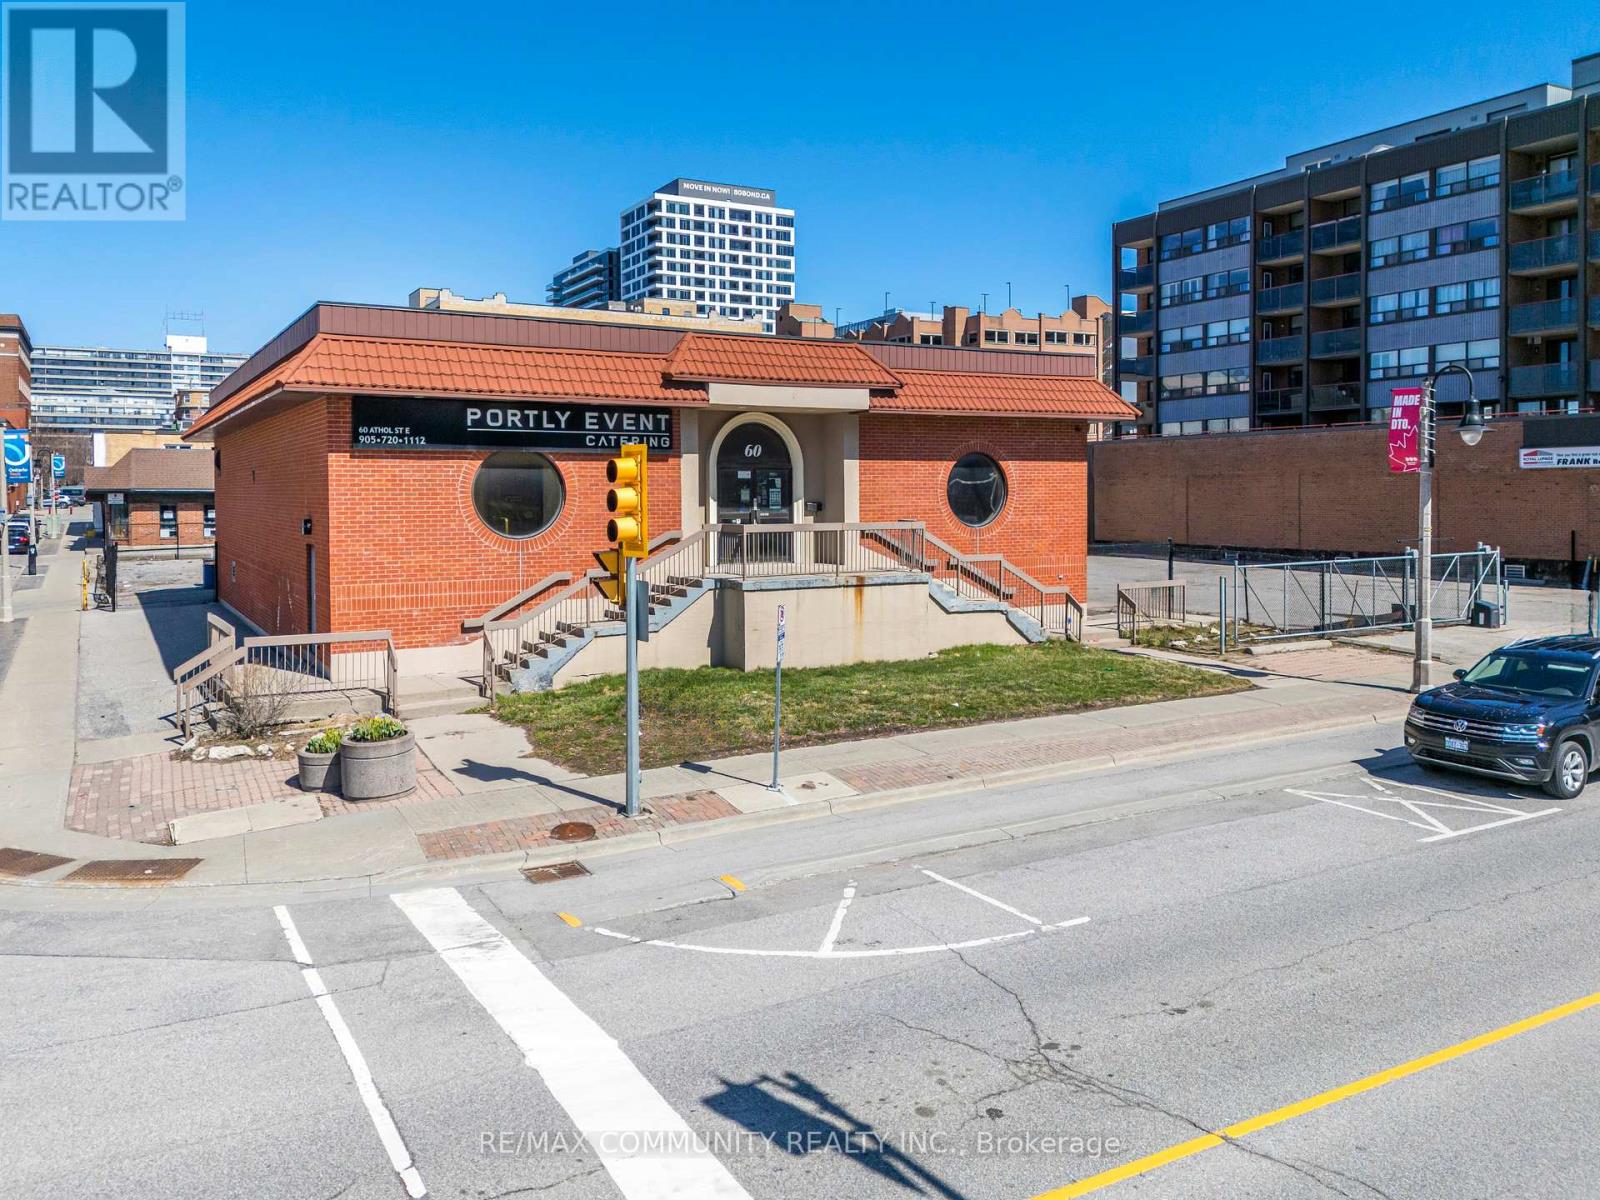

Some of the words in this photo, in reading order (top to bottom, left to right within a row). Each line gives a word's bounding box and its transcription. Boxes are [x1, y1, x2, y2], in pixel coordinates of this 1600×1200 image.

[683, 182, 703, 191] MOVE
[703, 184, 712, 192] IN
[1393, 394, 1421, 406] MADE
[1392, 407, 1402, 418] IN
[466, 407, 571, 429] PORTLY
[585, 412, 670, 431] EVENT
[1391, 418, 1411, 430] DTO.
[585, 435, 670, 447] CATERING
[744, 444, 762, 458] 60
[1556, 457, 1591, 466] FRANK
